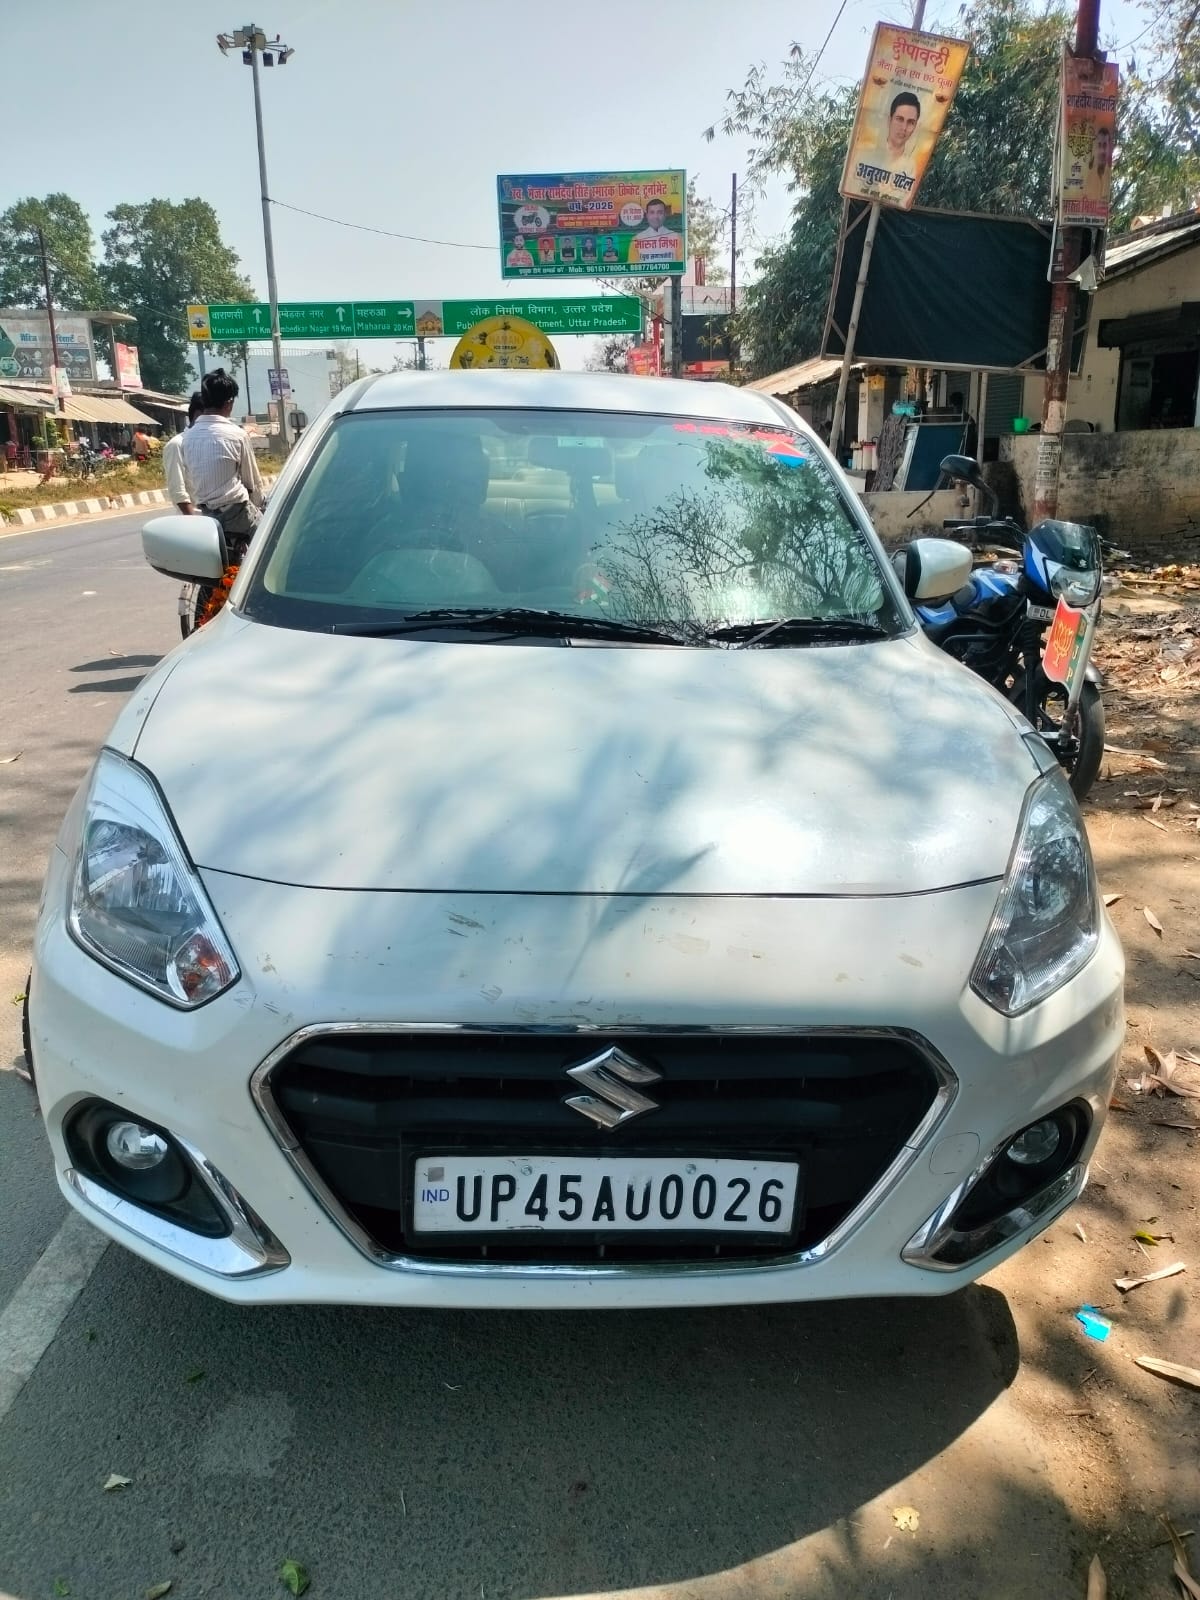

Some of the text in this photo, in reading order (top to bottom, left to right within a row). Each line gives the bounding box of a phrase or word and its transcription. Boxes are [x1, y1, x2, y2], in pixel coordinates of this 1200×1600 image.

[856, 163, 916, 191] अनुराग पटेल
[618, 183, 641, 197] क्रिकेट
[658, 236, 678, 249] मिश्रा
[212, 309, 243, 320] वाराणसी
[279, 309, 324, 319] म्बेडकर नगर
[356, 308, 386, 318] महरुआ
[470, 305, 490, 316] लोक
[495, 304, 523, 316] निर्माण
[562, 304, 586, 313] उत्तर
[591, 302, 613, 313] प्रदेश
[357, 322, 414, 332] Maharua 20 Km
[568, 318, 590, 327] Uttar
[593, 317, 627, 327] Pradesh
[211, 326, 245, 334] Varanasi
[247, 326, 258, 334] 171
[279, 324, 352, 333] mbedkar Nagar 19 Km
[1040, 608, 1051, 619] DL
[421, 1188, 450, 1203] IND
[455, 1173, 785, 1222] UP45AU0026
